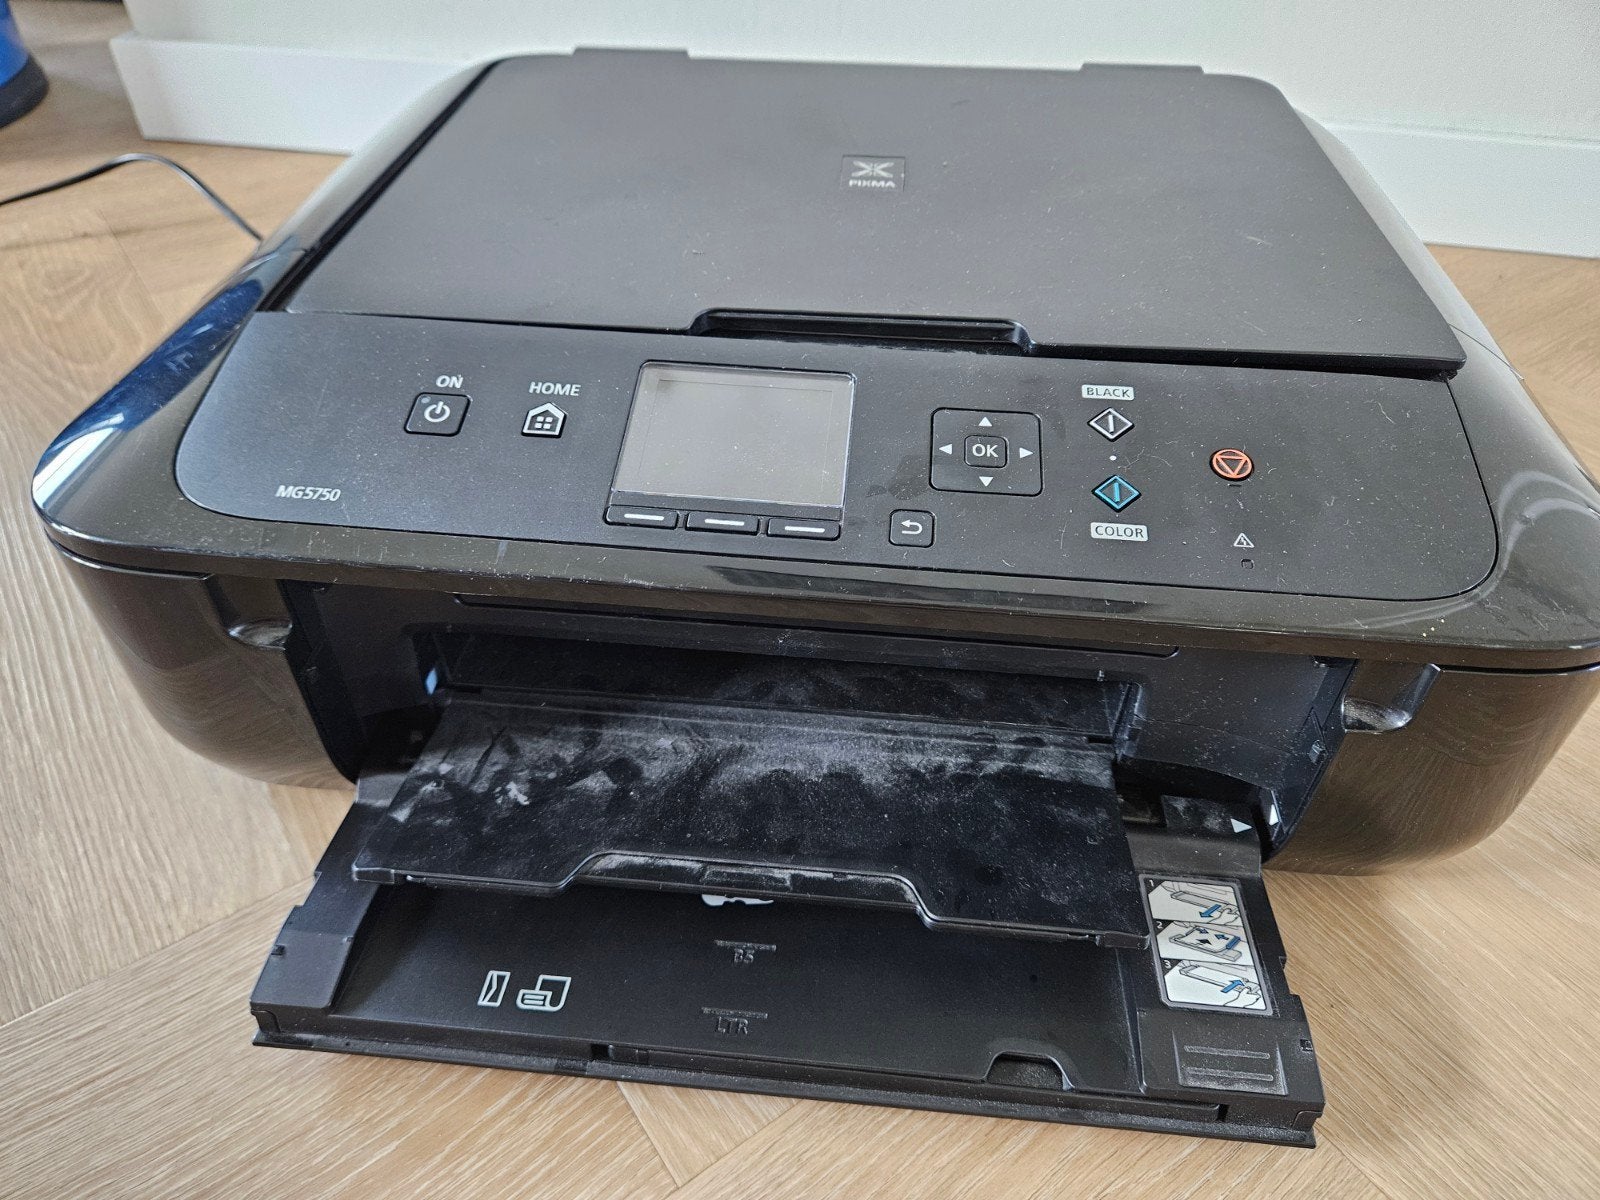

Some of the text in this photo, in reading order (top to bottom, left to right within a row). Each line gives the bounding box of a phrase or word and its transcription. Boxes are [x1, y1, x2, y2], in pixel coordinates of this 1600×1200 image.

[848, 179, 896, 188] PIXMA
[436, 375, 463, 389] ON
[528, 381, 581, 397] HOME
[1086, 387, 1131, 399] BLACK
[971, 443, 999, 458] OK
[275, 484, 341, 502] MG5750
[1094, 525, 1144, 539] COLOR
[1155, 920, 1164, 929] 2
[1163, 959, 1172, 969] 3
[716, 1015, 748, 1034] LTR
